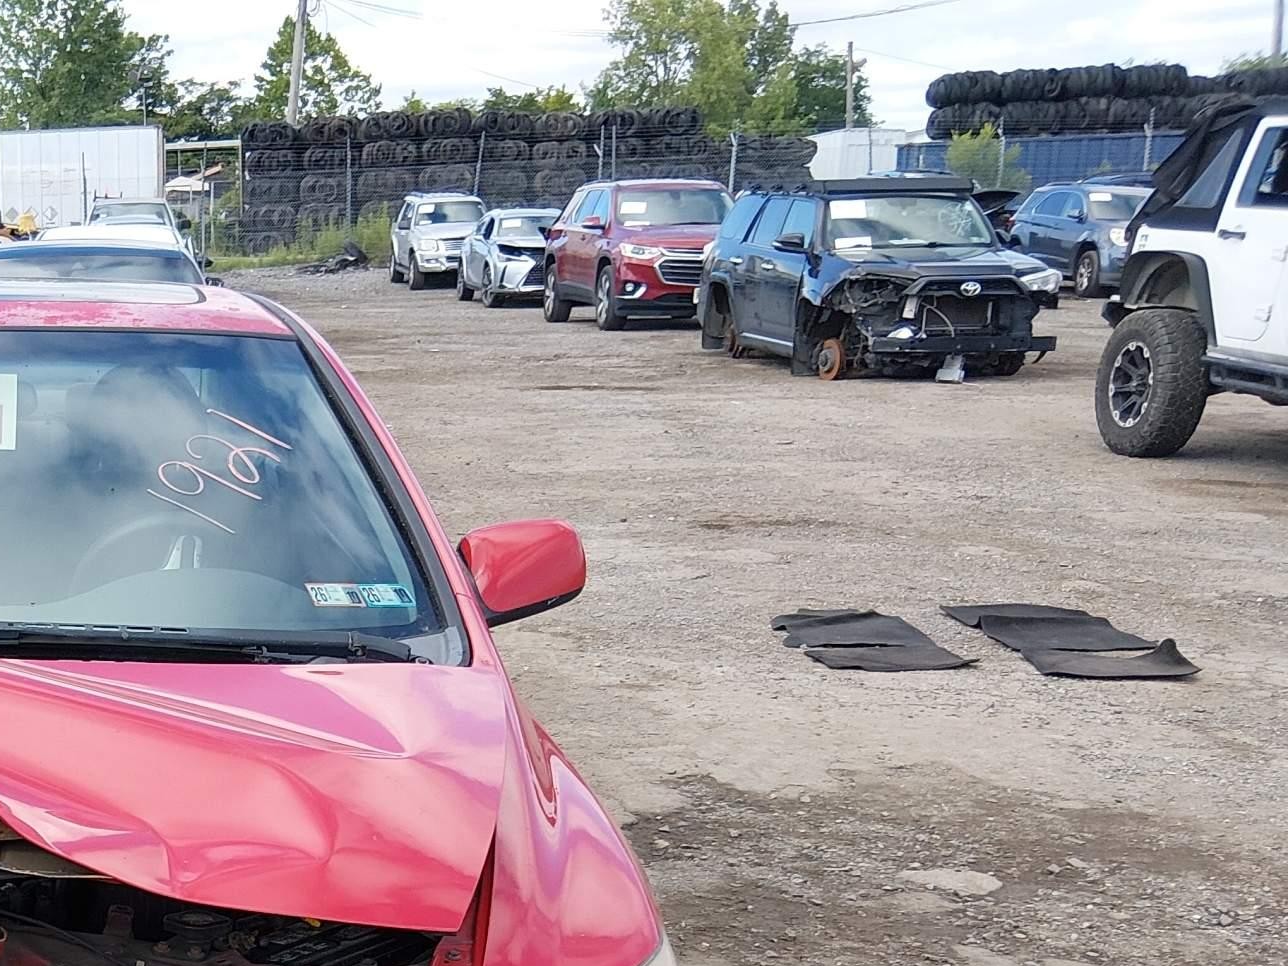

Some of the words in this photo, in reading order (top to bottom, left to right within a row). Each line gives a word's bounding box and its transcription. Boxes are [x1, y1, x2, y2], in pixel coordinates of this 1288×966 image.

[147, 408, 293, 534] 1921
[310, 586, 329, 603] 26
[362, 586, 381, 604] 26
